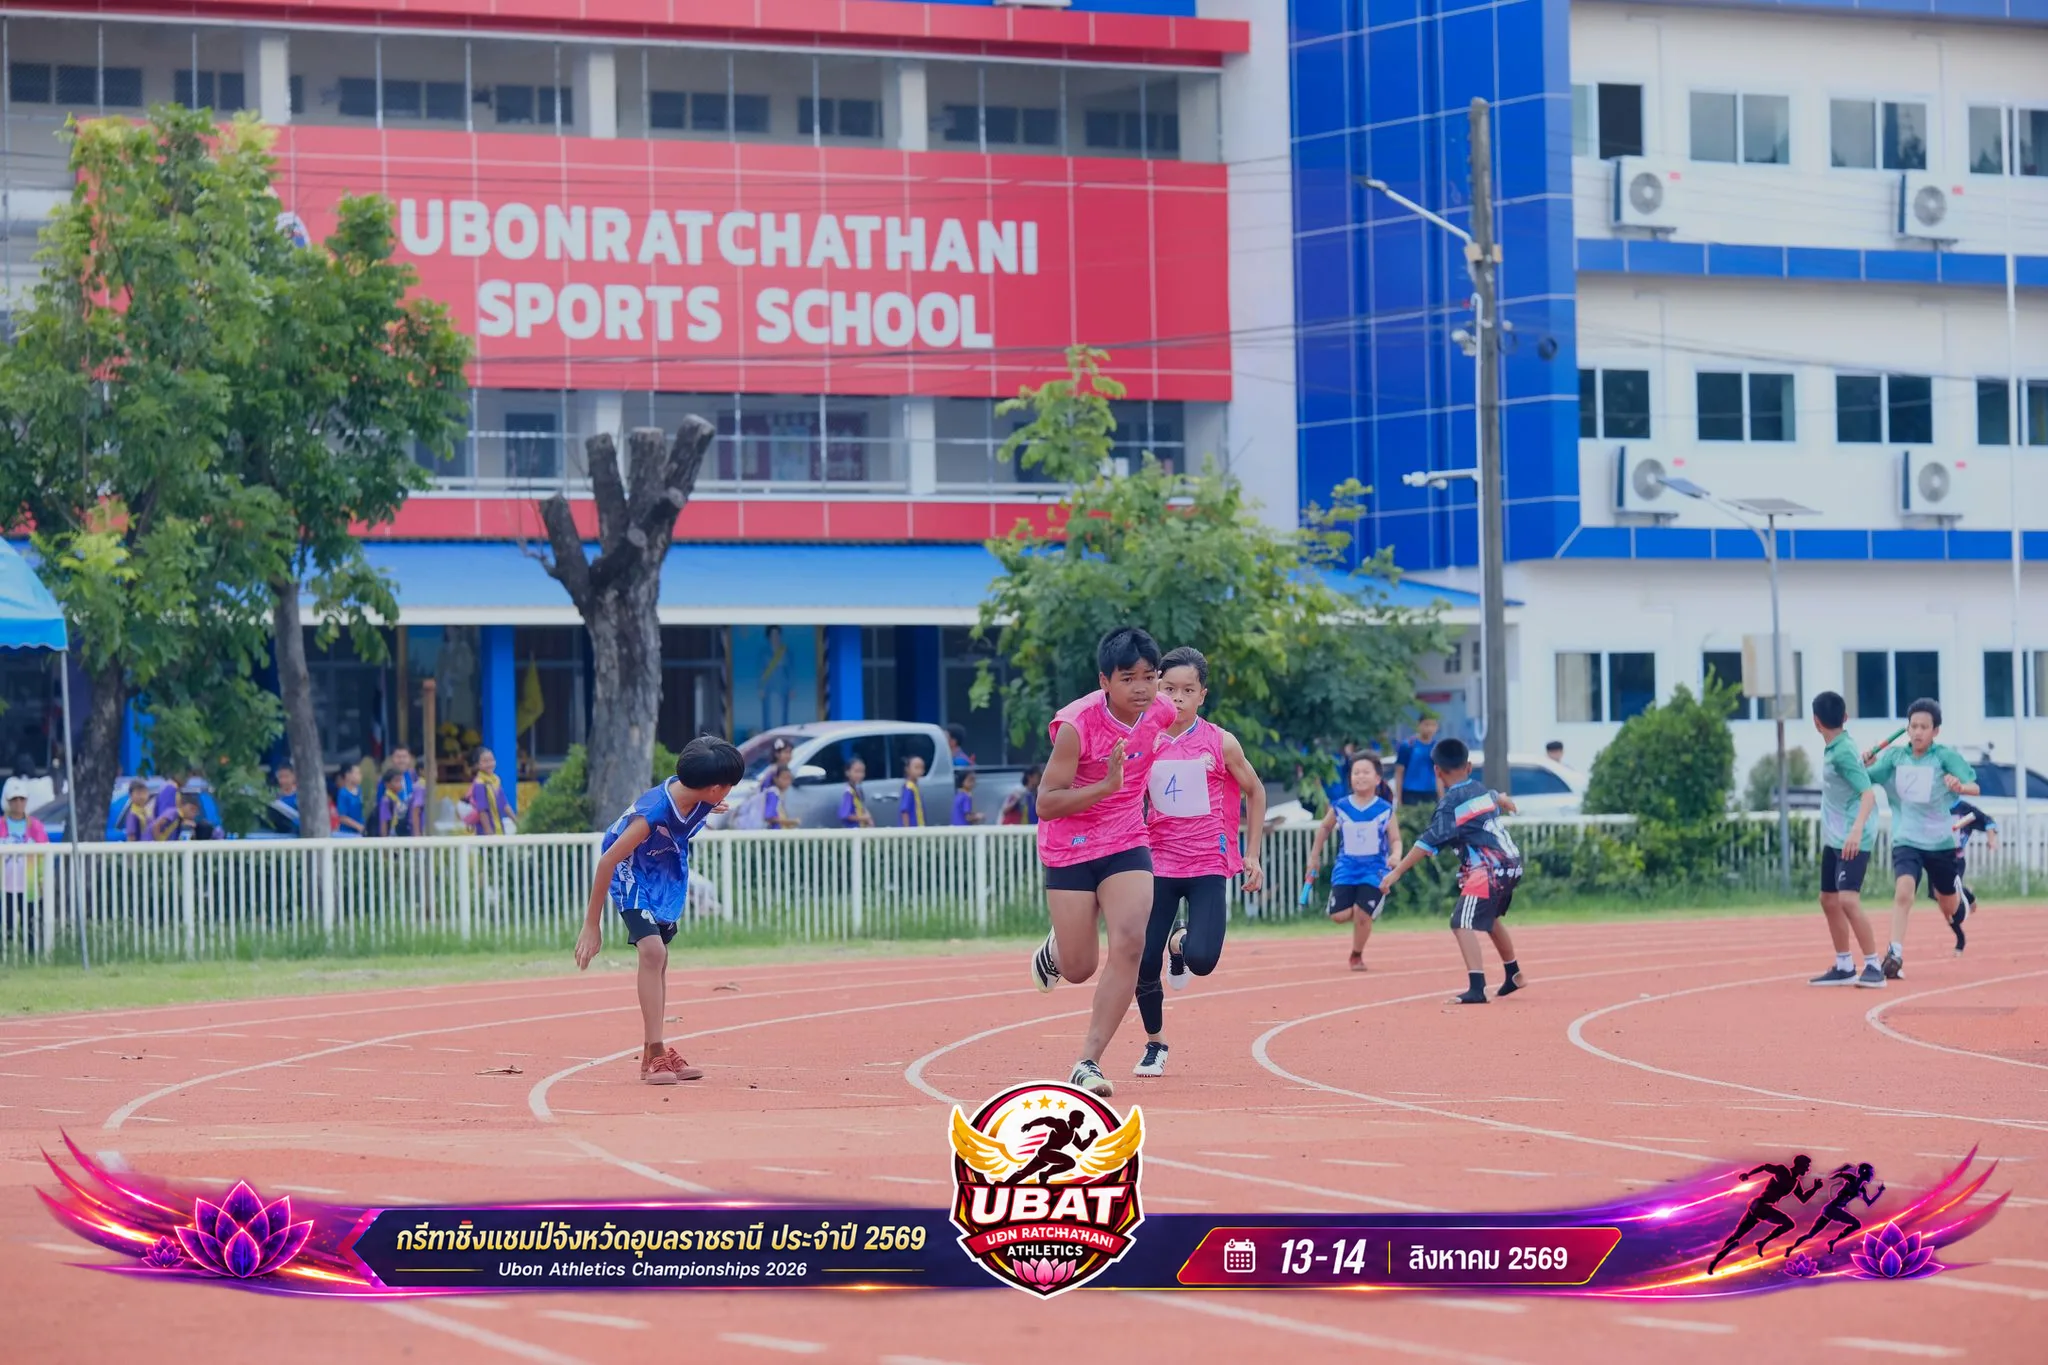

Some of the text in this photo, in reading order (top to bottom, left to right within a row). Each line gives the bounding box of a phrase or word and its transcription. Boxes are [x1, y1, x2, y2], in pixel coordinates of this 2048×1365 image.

[400, 198, 1039, 275] UBONRATCHATHANI
[477, 280, 994, 348] SPORTS SCHOOL
[1164, 773, 1183, 803] 4
